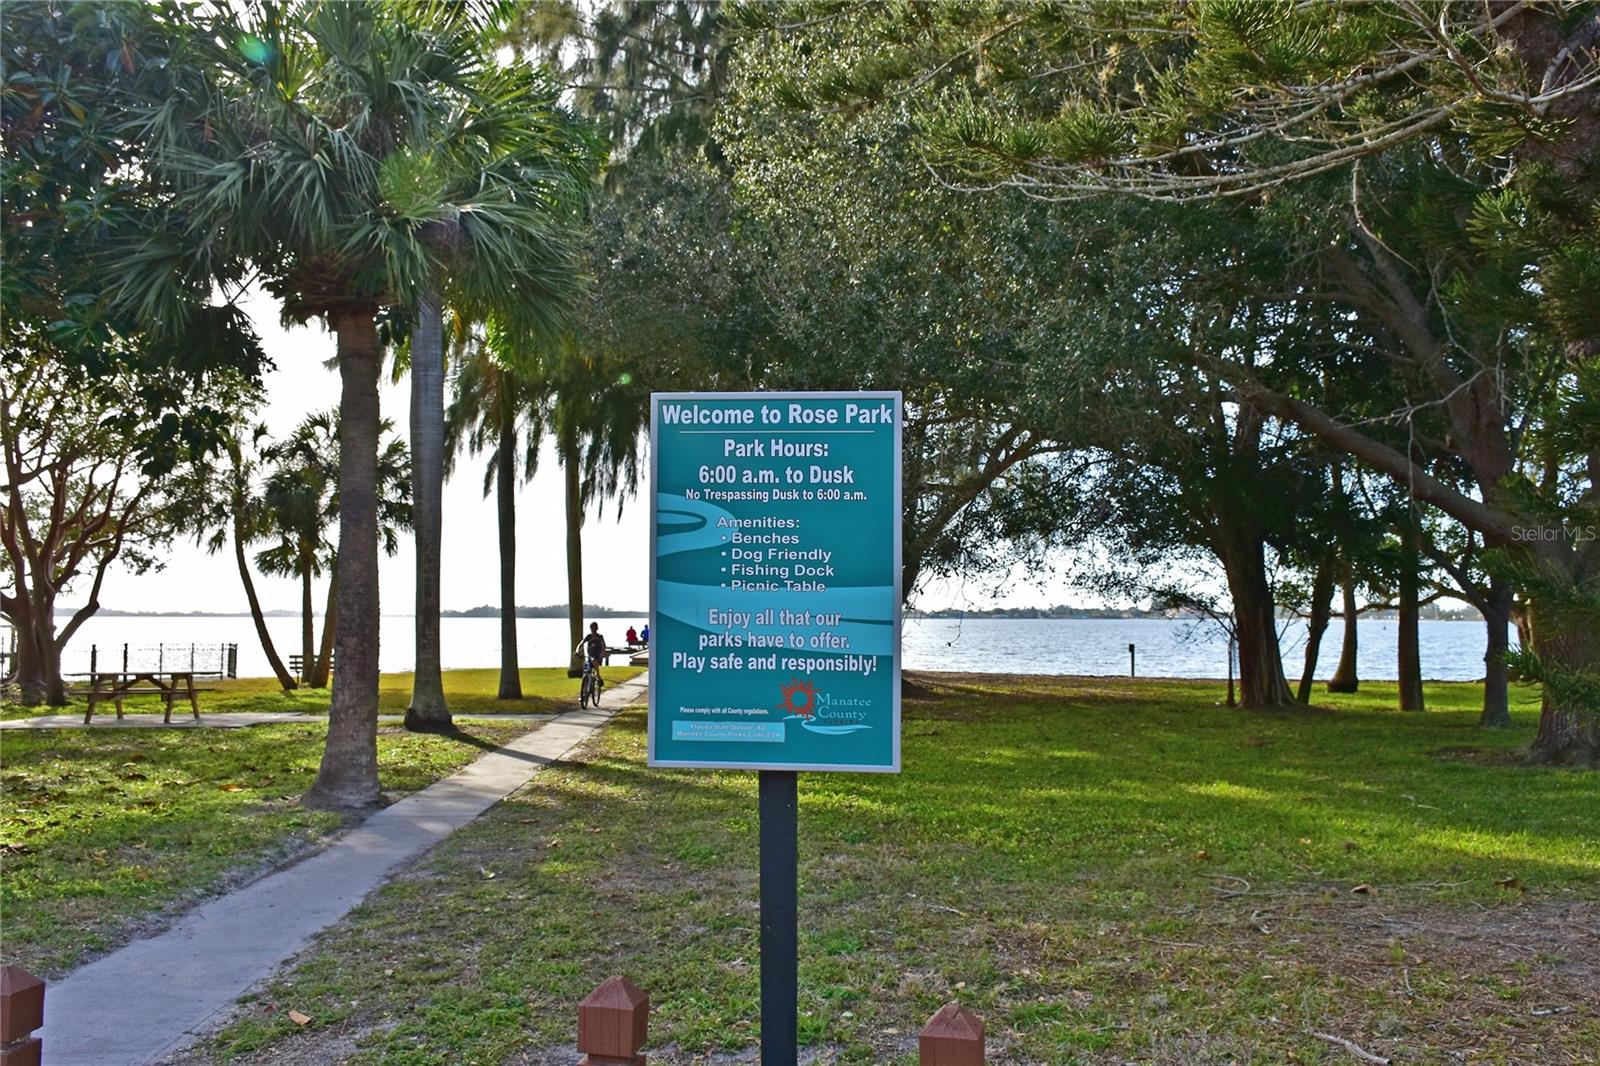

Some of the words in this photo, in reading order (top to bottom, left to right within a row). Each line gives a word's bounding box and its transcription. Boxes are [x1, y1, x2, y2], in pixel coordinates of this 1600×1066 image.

[662, 404, 754, 425] Welcome
[761, 404, 782, 424] to
[788, 404, 839, 424] Rose
[845, 404, 893, 424] Park
[724, 439, 764, 457] Park
[770, 439, 828, 457] Hours:
[699, 465, 736, 484] 6:00
[742, 468, 780, 484] a.m.
[786, 466, 804, 484] to
[809, 465, 854, 484] Dusk
[685, 489, 701, 500] No
[704, 488, 769, 502] Trespassing
[772, 488, 799, 500] Dusk
[802, 489, 814, 500] to
[817, 488, 840, 500] 6:00
[843, 490, 868, 500] a.m.
[717, 516, 800, 529] Amenities:
[731, 532, 800, 544] Benches
[731, 548, 763, 563] Dog
[767, 548, 832, 563] Friendly
[731, 564, 789, 578] Fishing
[794, 564, 835, 577] Dock
[731, 580, 779, 592] Picnic
[784, 580, 826, 593] Table
[708, 608, 751, 630] Enjoy
[755, 609, 774, 626] all
[779, 609, 811, 626] that
[815, 612, 842, 626] our
[699, 631, 743, 651] parks
[747, 632, 784, 648] have
[789, 633, 805, 649] to
[809, 632, 850, 649] offer.
[672, 652, 705, 674] Play
[710, 653, 743, 670] safe
[748, 654, 776, 671] and
[781, 655, 877, 676] responsibly!
[815, 692, 872, 706] Manatee
[695, 707, 711, 715] comply
[728, 707, 743, 716] County
[818, 705, 867, 721] County
